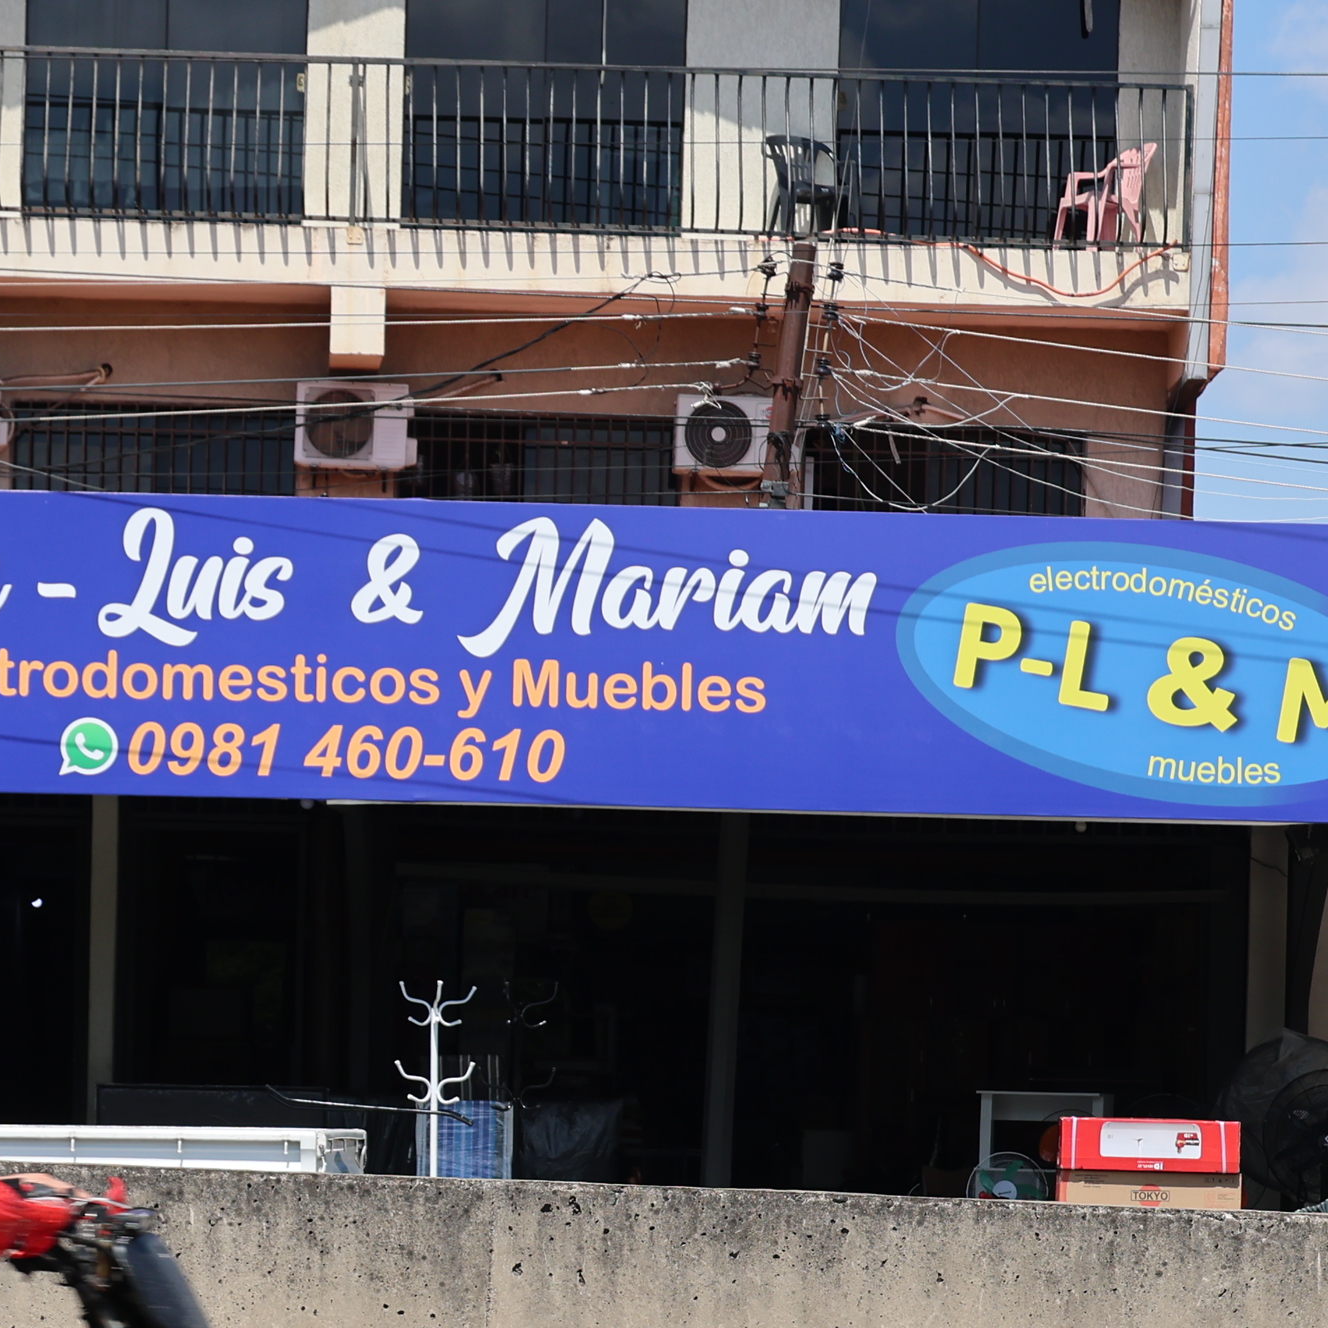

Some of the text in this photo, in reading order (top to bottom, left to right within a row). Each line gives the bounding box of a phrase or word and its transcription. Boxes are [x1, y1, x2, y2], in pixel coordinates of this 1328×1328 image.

[97, 507, 294, 646] Luis
[350, 533, 423, 624] &
[456, 516, 877, 657] Mariam
[1029, 566, 1297, 631] electrodomésticos
[457, 669, 492, 719] y
[512, 658, 767, 713] Muebles
[953, 602, 1109, 712] P-L
[1147, 636, 1238, 733] &
[127, 721, 567, 783] 0981 460-610
[1147, 754, 1281, 785] muebles
[1133, 1191, 1168, 1201] TOKYO
